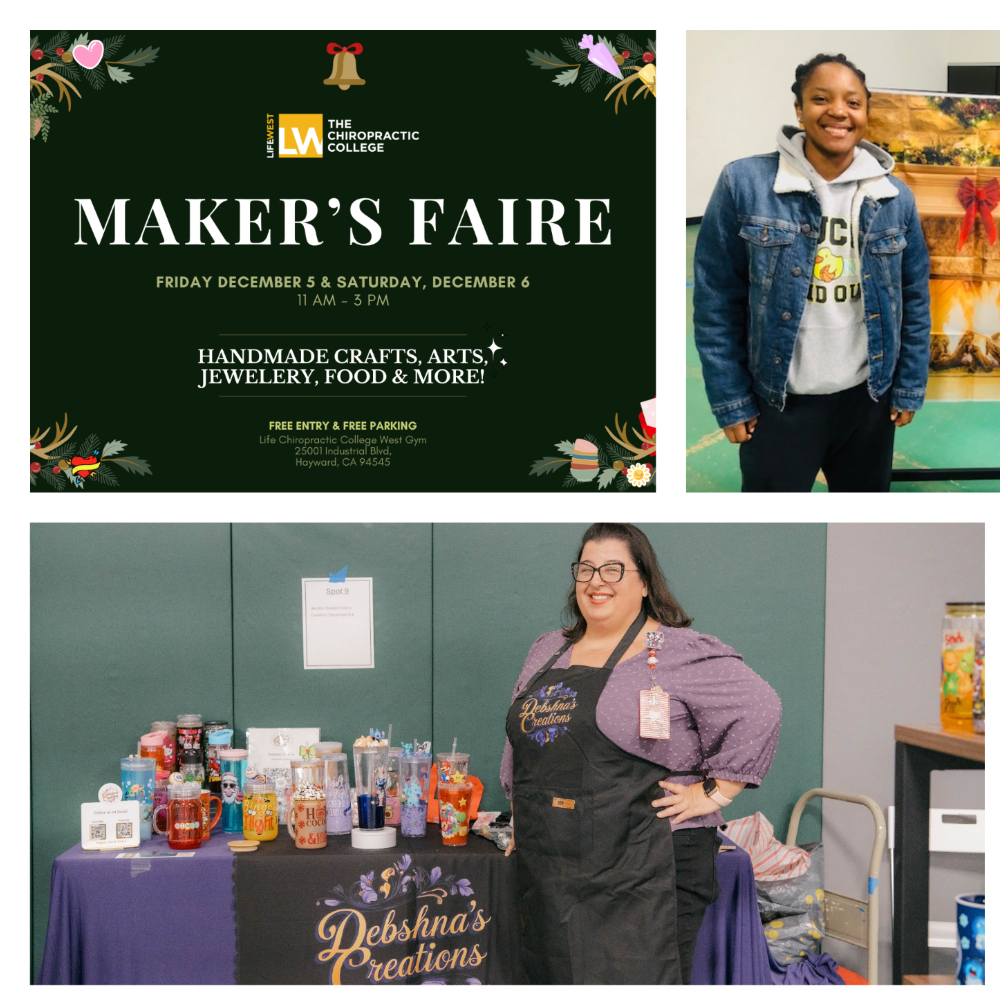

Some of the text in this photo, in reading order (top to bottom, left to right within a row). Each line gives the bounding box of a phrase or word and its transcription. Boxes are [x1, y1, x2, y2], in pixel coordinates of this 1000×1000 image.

[327, 119, 352, 129] THE
[266, 113, 275, 158] LIFEWEST
[327, 131, 420, 141] CHIROPRACTIC
[327, 143, 384, 153] COLLEGE
[74, 197, 612, 246] MAKER’S FAIRE
[817, 216, 854, 248] UC
[156, 276, 530, 291] FRIDAY DECEMBER 5 & SATURDAY, DECEMBER 6
[834, 283, 861, 303] OU
[298, 294, 307, 306] 11
[313, 294, 336, 306] AM
[354, 294, 363, 306] 3
[368, 294, 389, 306] PM
[198, 349, 488, 367] HANDMADE CRAFTS, ARTS,
[197, 369, 485, 388] JEWELERY, FOOD & MORE!
[269, 421, 418, 430] FREE ENTRY & FREE PARKING
[259, 435, 427, 447] Life Chiropractic College West Gym
[295, 446, 392, 456] 25001 Industrial Blvd,
[295, 458, 391, 469] Hayward, CA 94545
